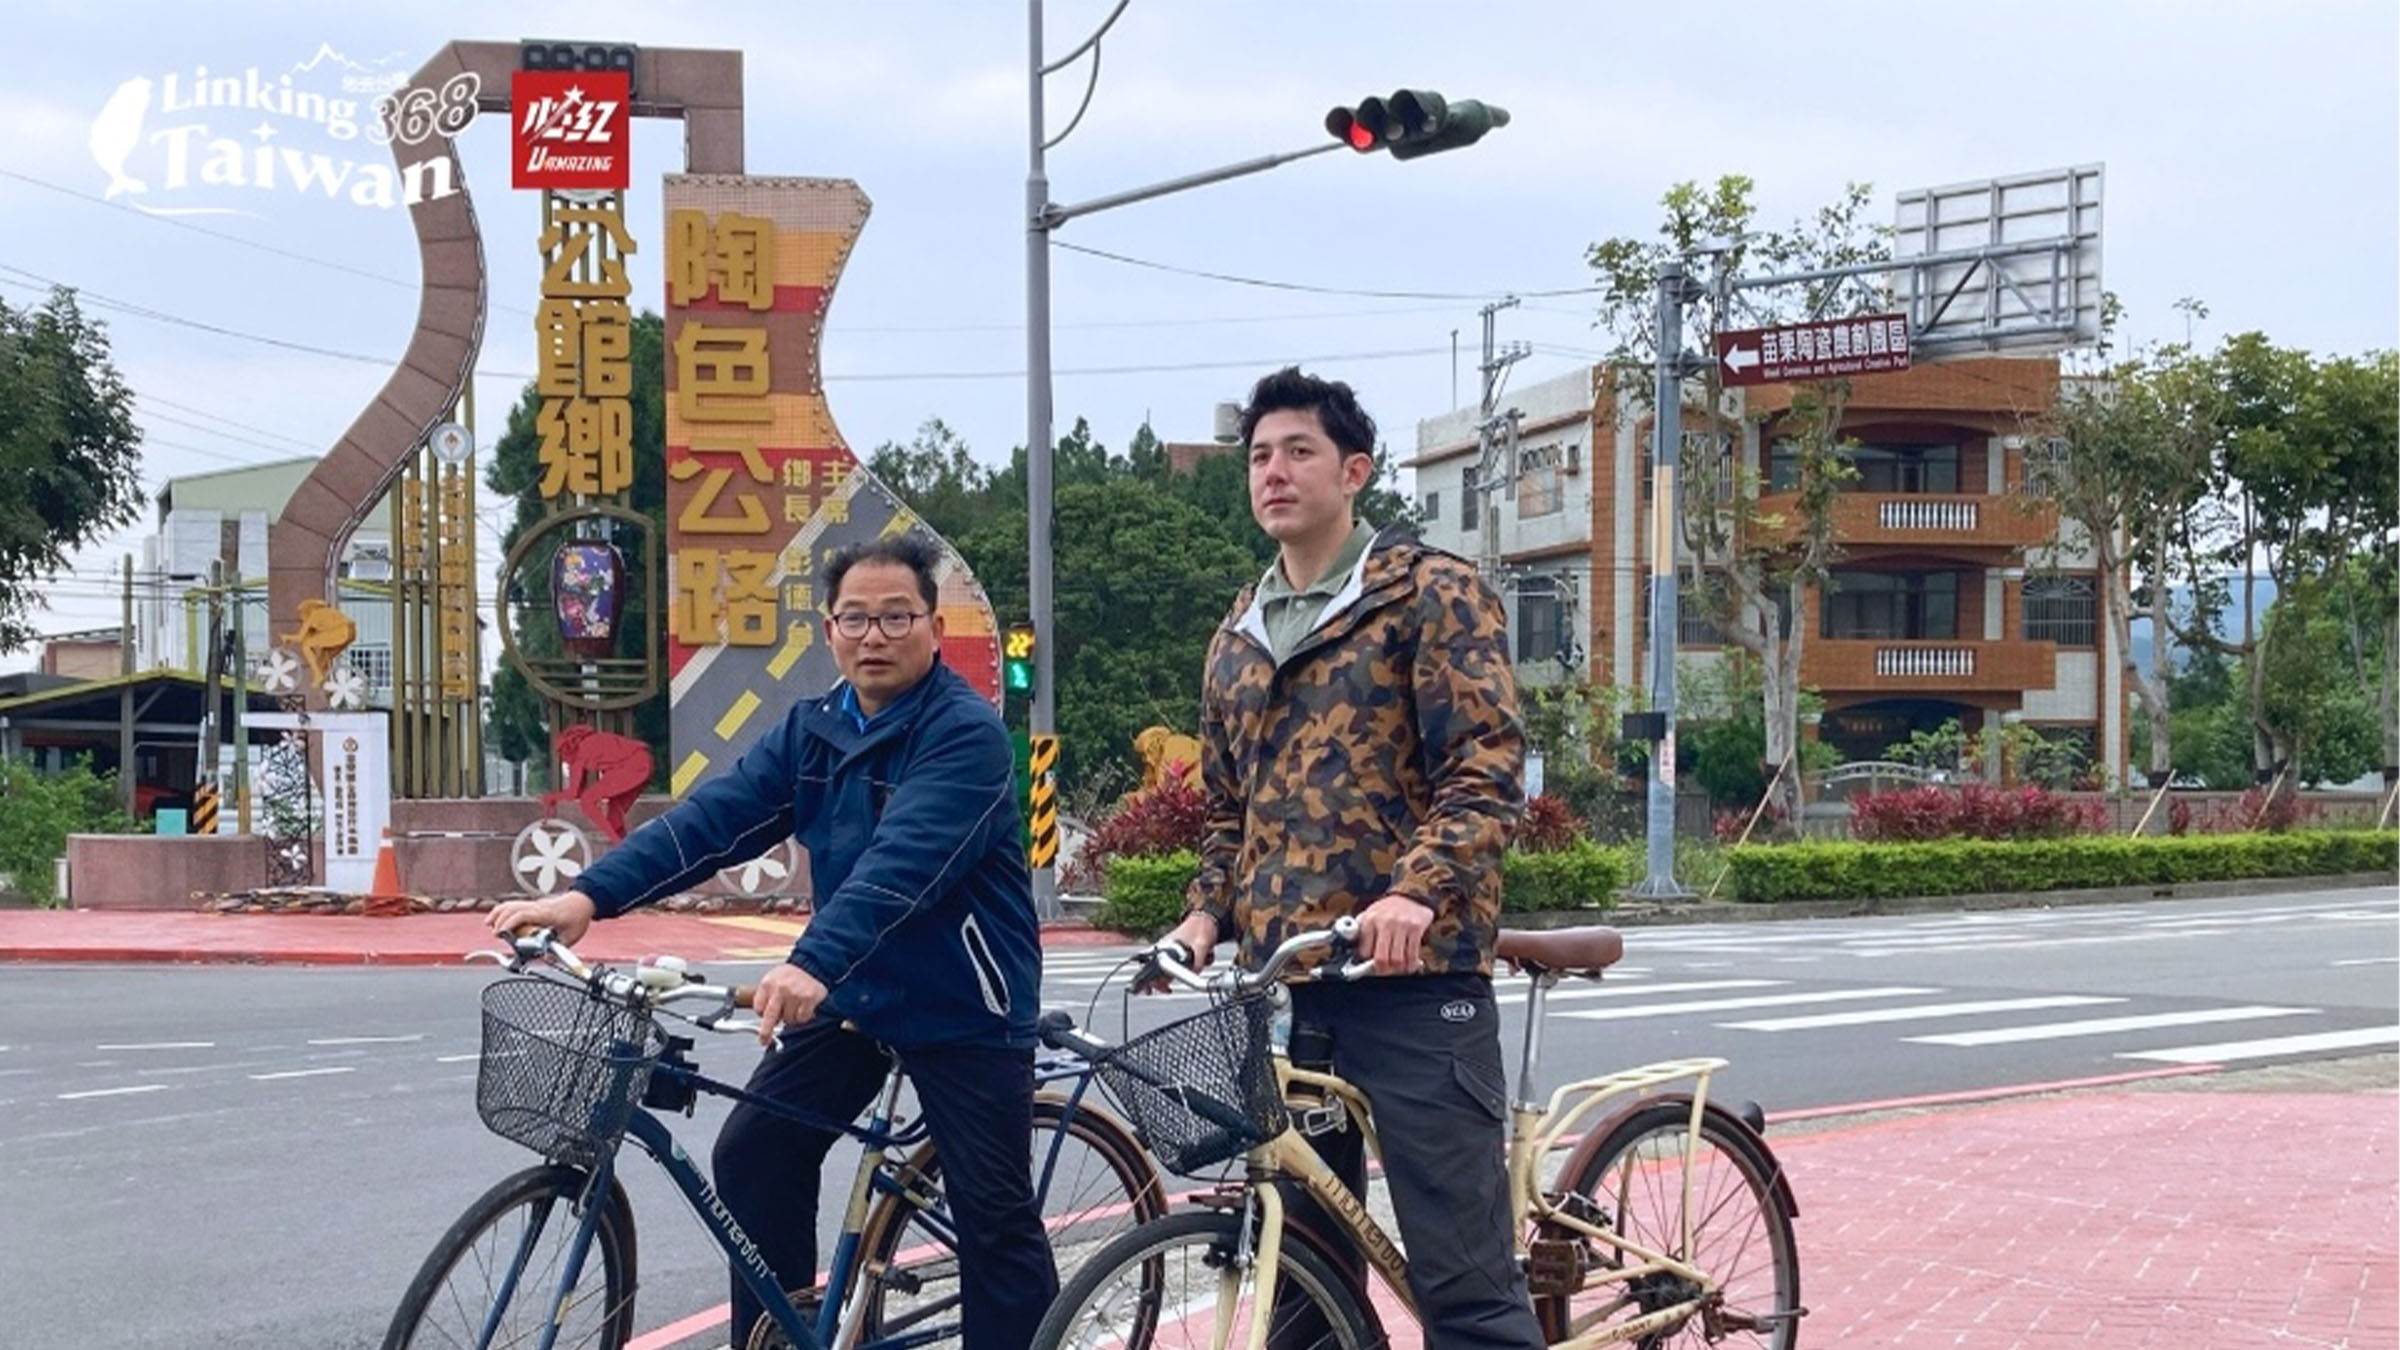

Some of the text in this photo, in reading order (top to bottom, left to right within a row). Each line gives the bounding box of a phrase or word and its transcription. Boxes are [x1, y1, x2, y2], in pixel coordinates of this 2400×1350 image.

[535, 207, 637, 499] 公館鄉
[670, 209, 779, 648] 陶色公路
